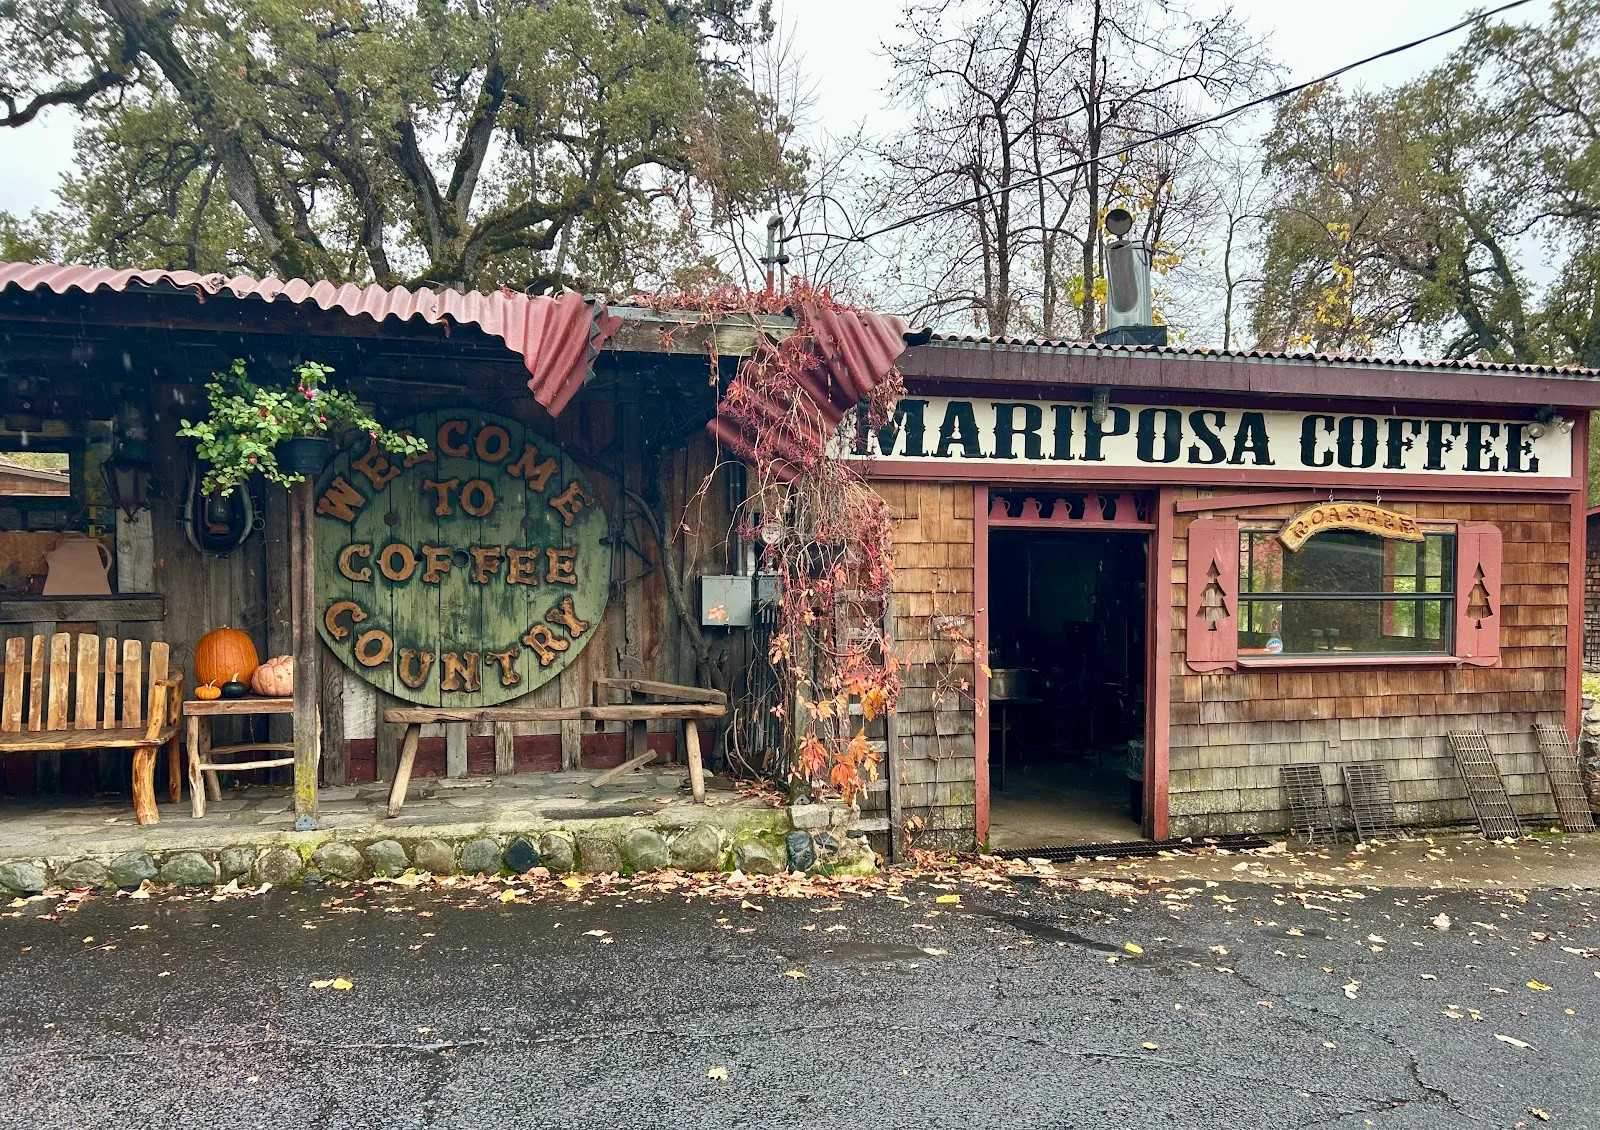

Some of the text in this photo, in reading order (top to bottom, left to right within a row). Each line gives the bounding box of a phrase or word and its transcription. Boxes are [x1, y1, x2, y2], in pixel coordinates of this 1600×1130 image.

[850, 396, 1540, 474] MARIPOSA COFFEE
[422, 479, 498, 517] TO
[1290, 506, 1415, 538] ROASTER
[338, 543, 579, 585] COFFEE
[325, 597, 589, 692] COUNTRY
